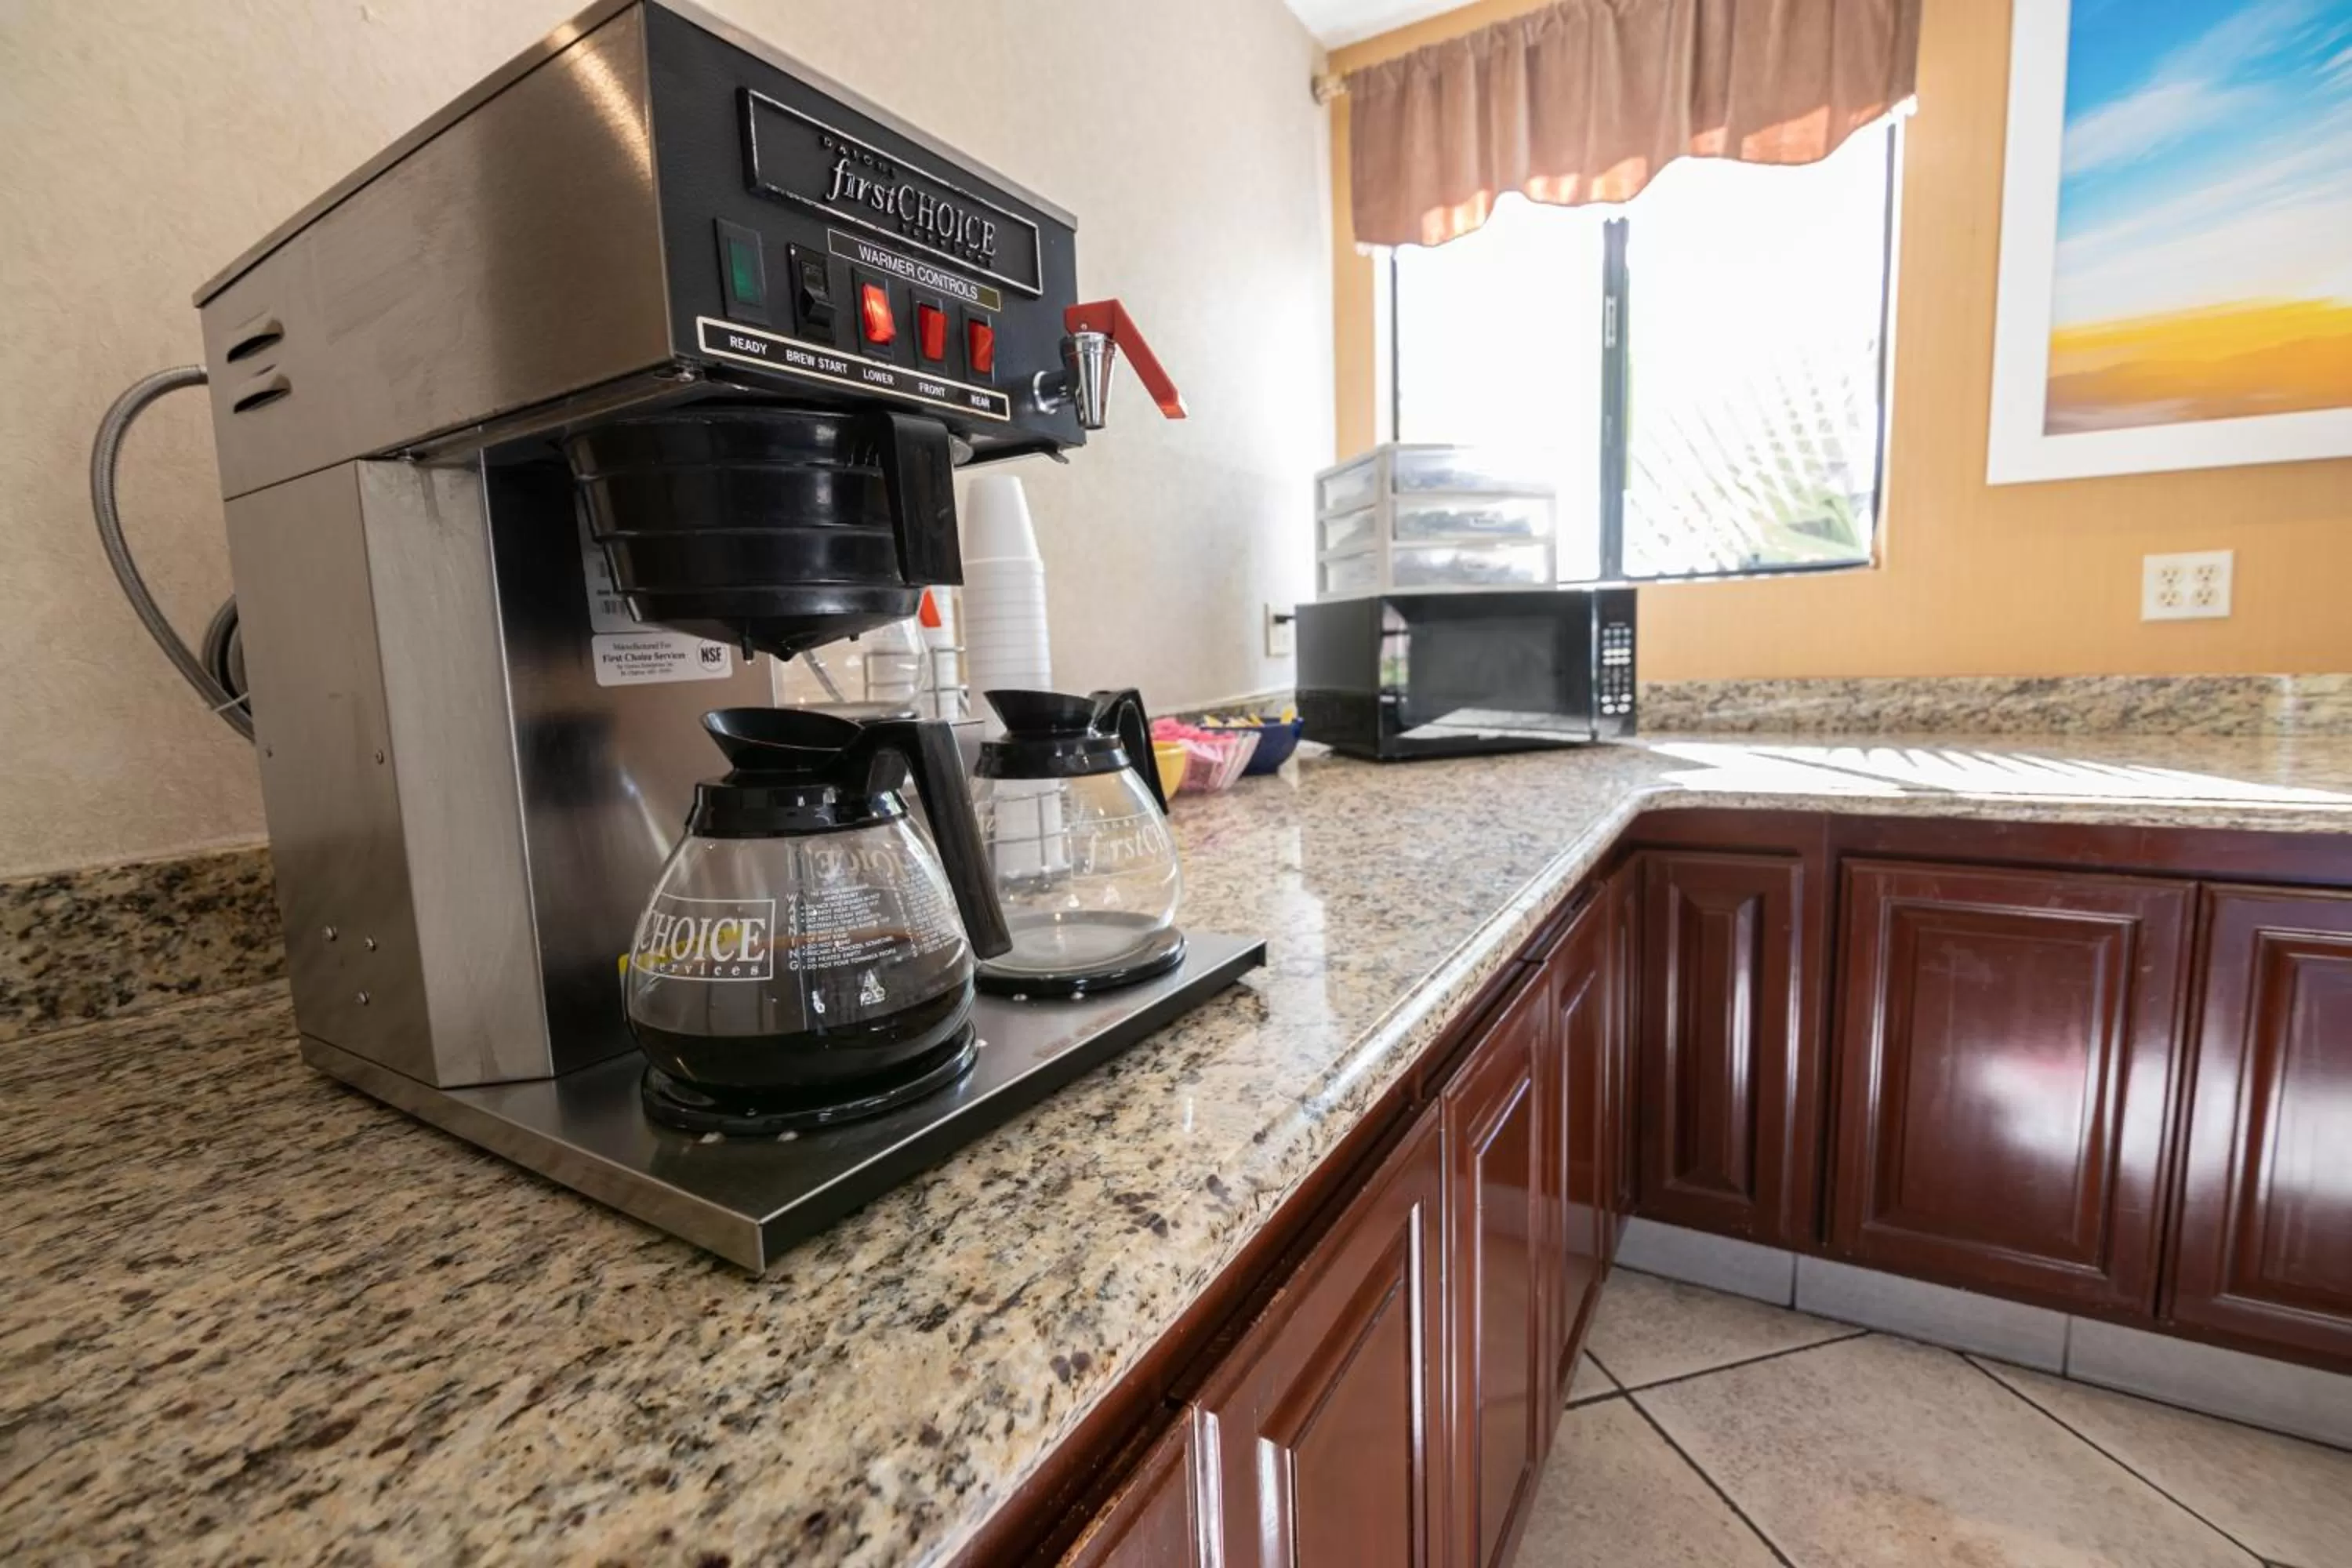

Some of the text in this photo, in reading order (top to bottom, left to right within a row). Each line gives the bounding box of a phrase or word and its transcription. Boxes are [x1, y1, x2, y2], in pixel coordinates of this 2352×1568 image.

[858, 245, 978, 300] WARMER CONTROLS
[730, 336, 768, 355] READY
[786, 350, 848, 374] BREW START
[863, 368, 894, 385] LOWER
[918, 382, 946, 397] FRONT
[971, 394, 990, 408] REAR
[701, 647, 722, 662] NSF
[659, 962, 759, 976] ervices
